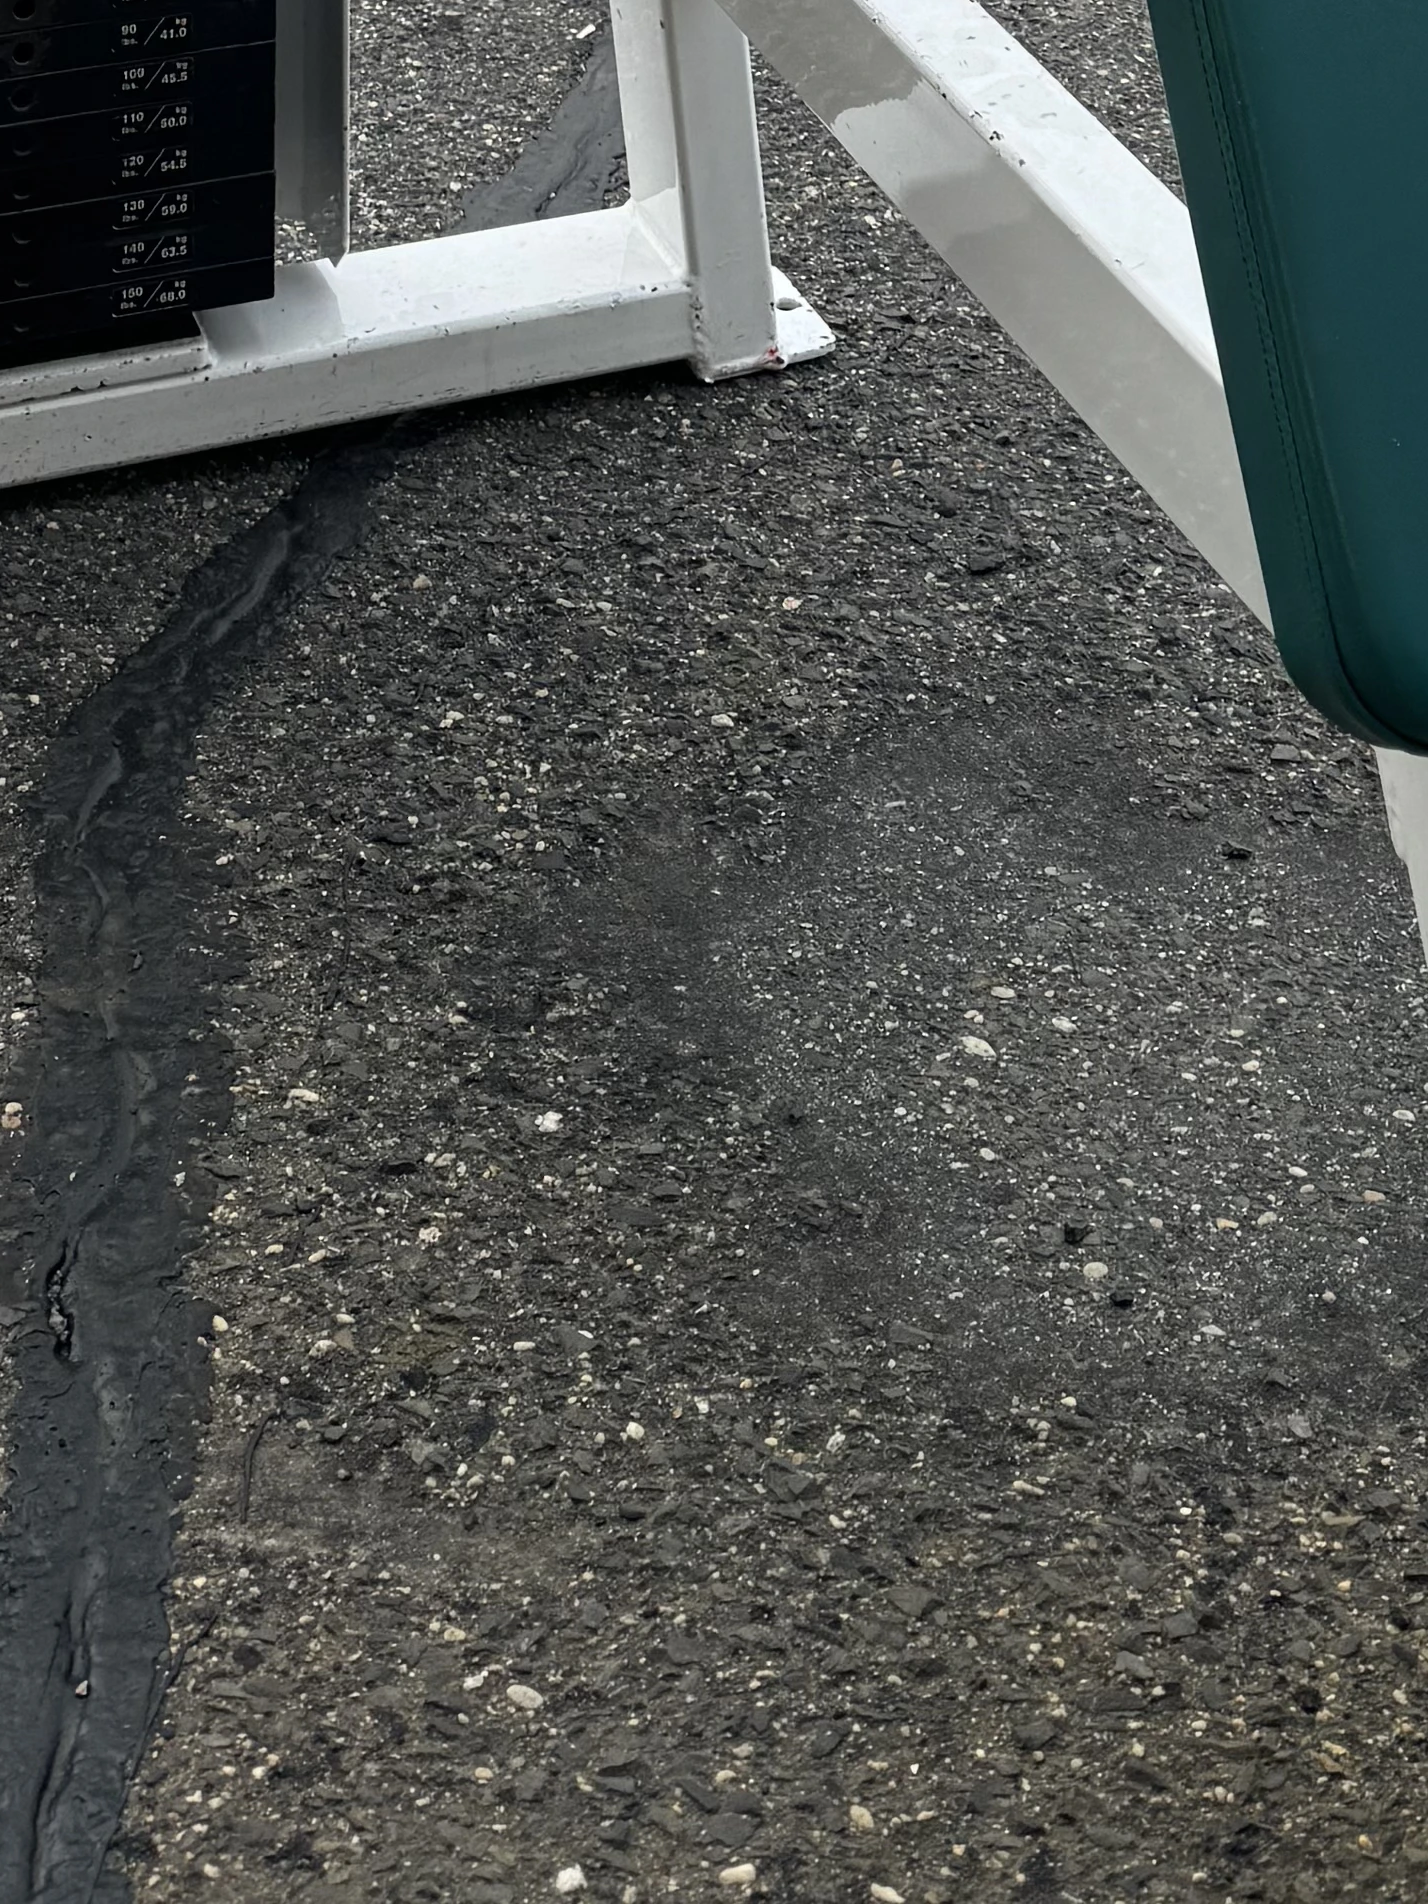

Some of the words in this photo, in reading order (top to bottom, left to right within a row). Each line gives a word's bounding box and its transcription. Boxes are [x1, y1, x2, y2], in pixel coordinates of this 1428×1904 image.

[121, 24, 137, 35] 90
[160, 27, 187, 39] 41.0
[123, 67, 145, 80] 100
[123, 112, 144, 124] 110
[124, 199, 145, 212] 130
